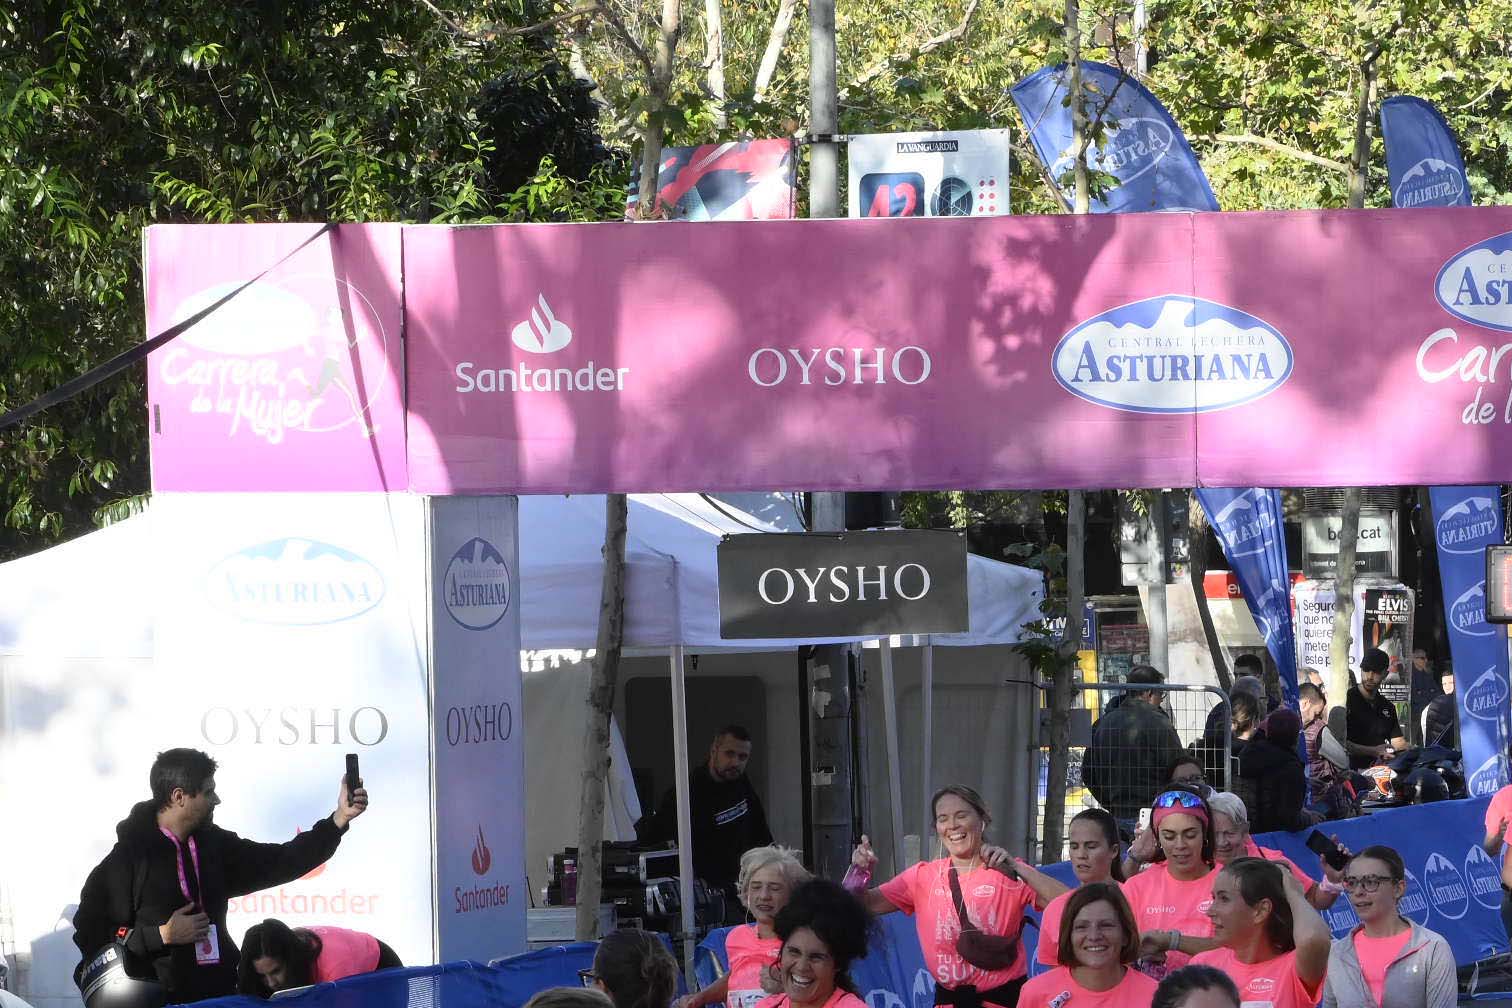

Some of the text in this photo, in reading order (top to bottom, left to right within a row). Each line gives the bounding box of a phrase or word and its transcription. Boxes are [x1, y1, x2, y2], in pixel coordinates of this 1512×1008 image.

[455, 360, 630, 393] Santander
[748, 346, 932, 387] OYSHO
[1071, 340, 1275, 383] ASTURIANA
[1461, 386, 1497, 425] de
[449, 572, 507, 607] ASTURIANA
[757, 564, 931, 606] OYSHO
[1303, 614, 1321, 626] que
[1378, 598, 1409, 611] ELVIS
[1304, 654, 1324, 665] este
[200, 705, 389, 747] OYSHO
[446, 702, 512, 747] OYSHO
[454, 881, 511, 914] Santander
[937, 954, 952, 964] TU
